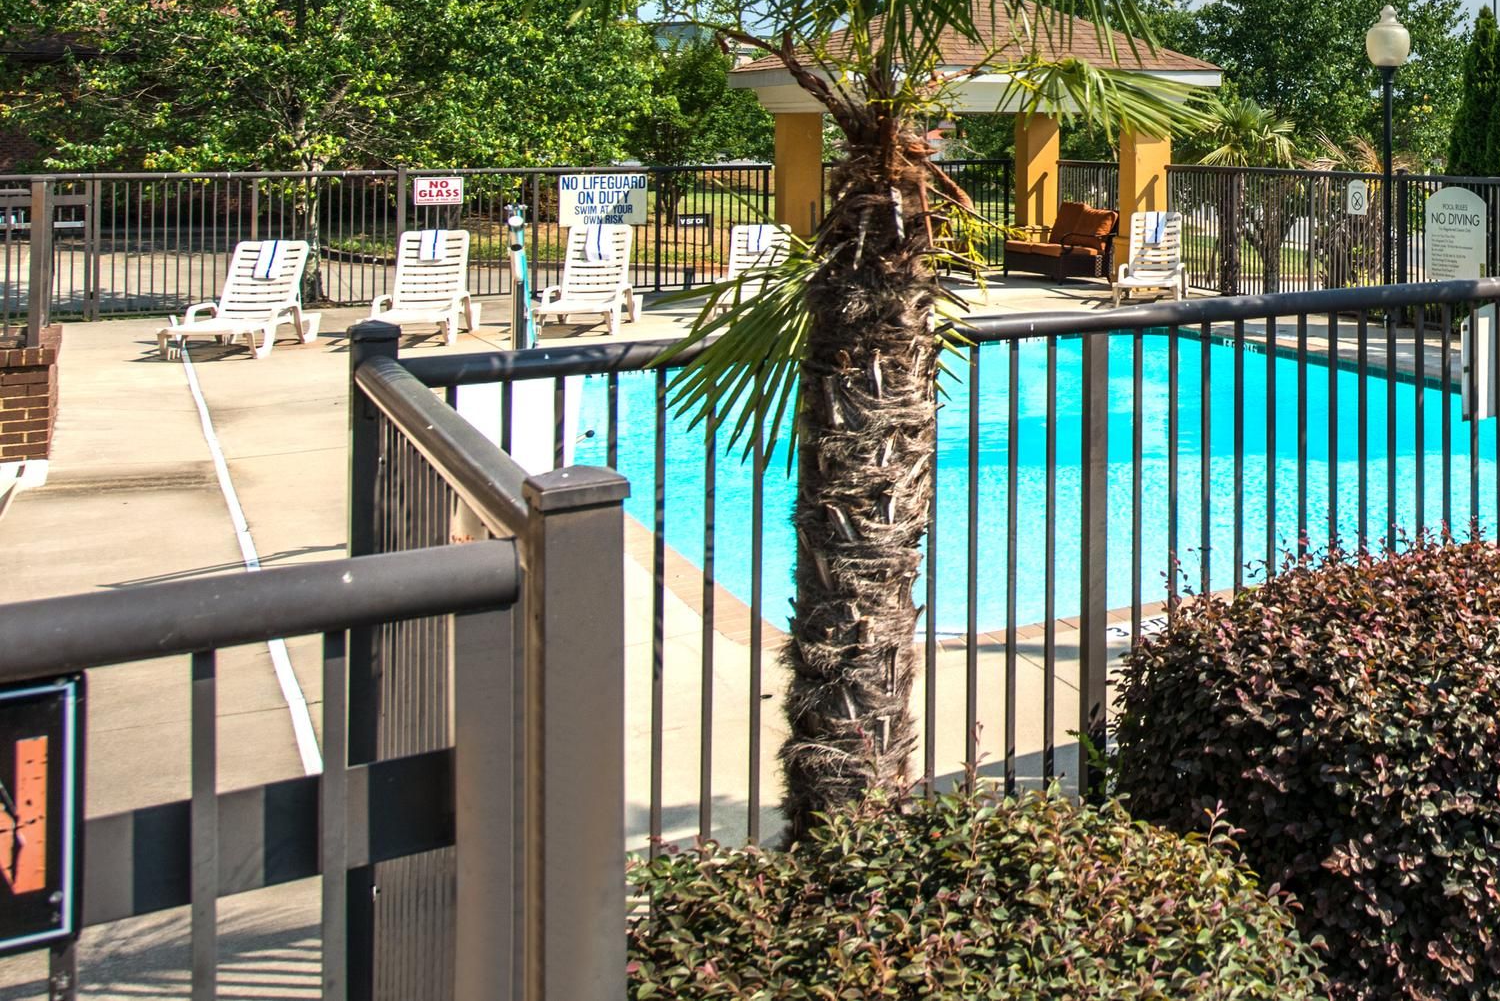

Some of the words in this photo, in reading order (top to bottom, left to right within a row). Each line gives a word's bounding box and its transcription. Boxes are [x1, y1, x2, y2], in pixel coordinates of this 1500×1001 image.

[429, 180, 449, 188] NO
[561, 176, 578, 190] NO
[583, 175, 646, 190] LIFEGUARD
[418, 189, 459, 197] GLASS
[578, 191, 594, 204] ON
[599, 190, 630, 204] DUTY
[575, 206, 597, 215] SWIM
[600, 206, 609, 214] AT
[613, 204, 632, 214] YOUR
[583, 216, 602, 224] OWN
[605, 214, 624, 224] RISK
[1431, 212, 1446, 224] NO
[1449, 213, 1480, 226] DIVING
